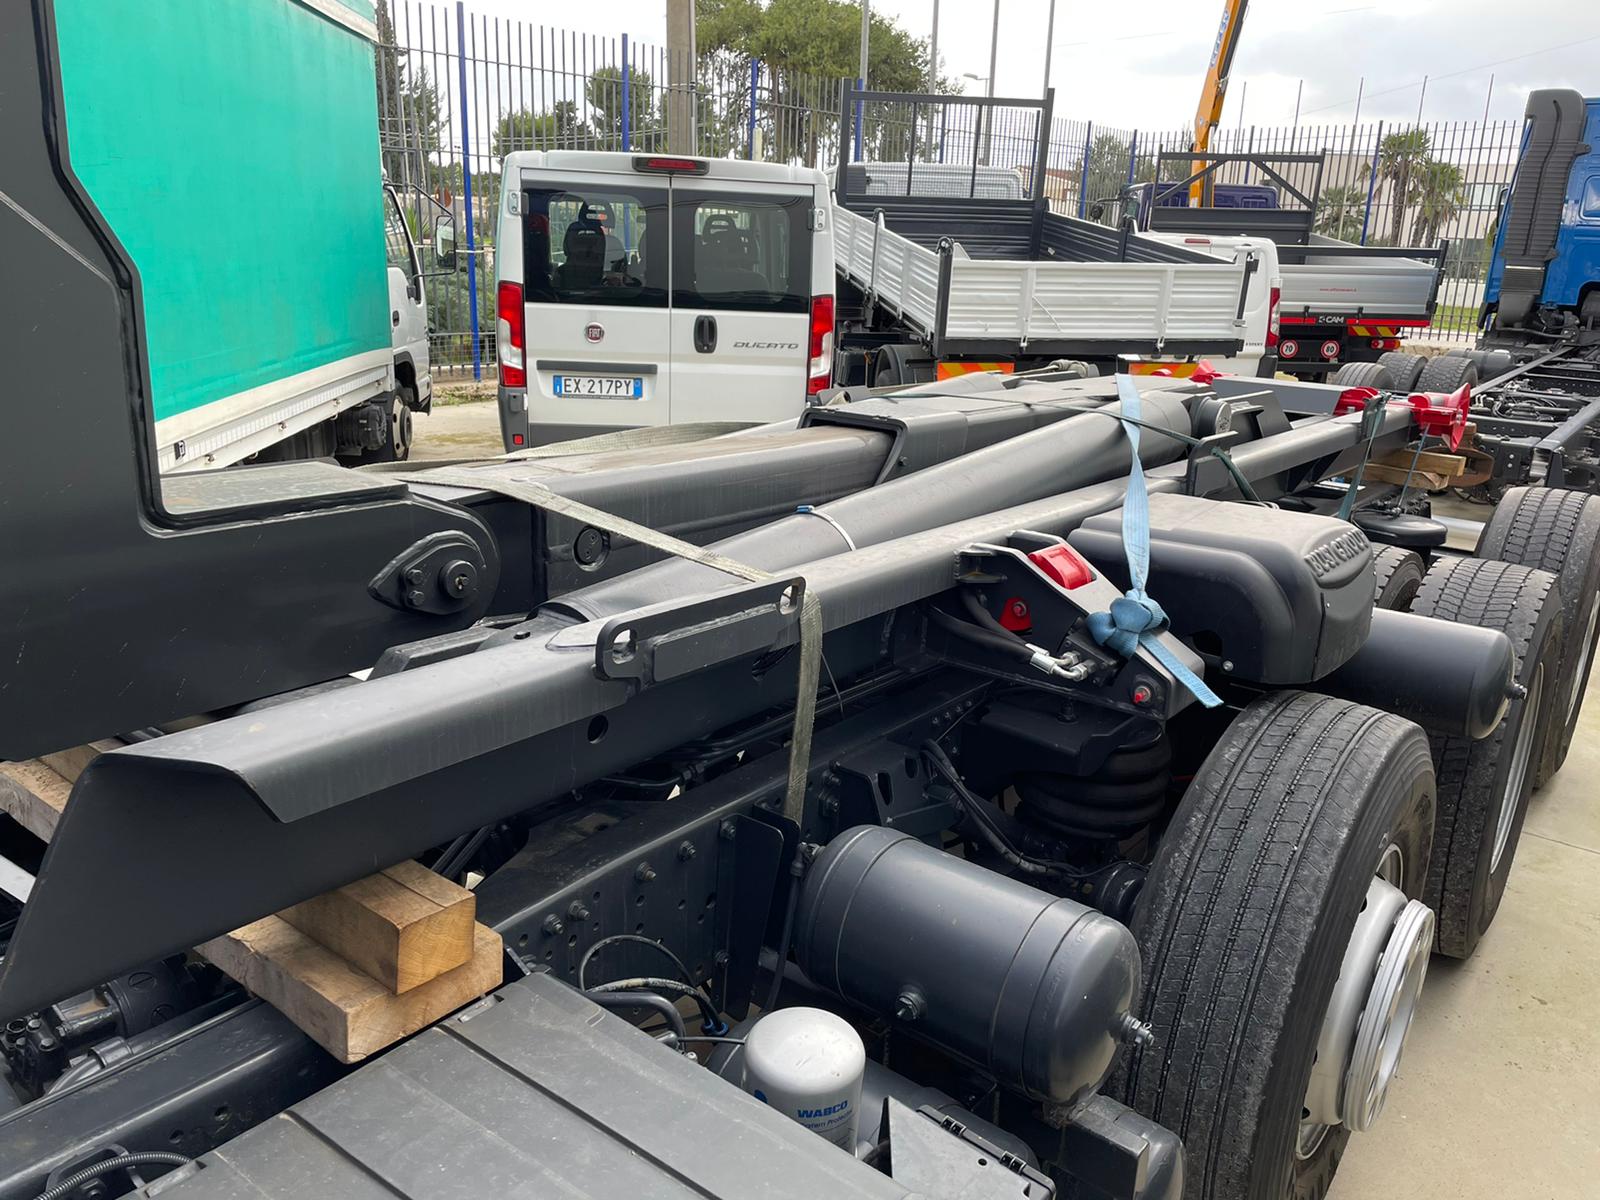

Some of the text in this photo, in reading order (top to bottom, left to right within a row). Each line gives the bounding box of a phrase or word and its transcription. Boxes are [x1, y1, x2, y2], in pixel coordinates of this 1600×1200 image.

[733, 341, 799, 350] DUCATO
[1284, 344, 1294, 353] 70
[1325, 344, 1335, 354] 80
[563, 378, 582, 394] EX
[587, 379, 632, 395] 217PY
[797, 1100, 848, 1119] WABCO
